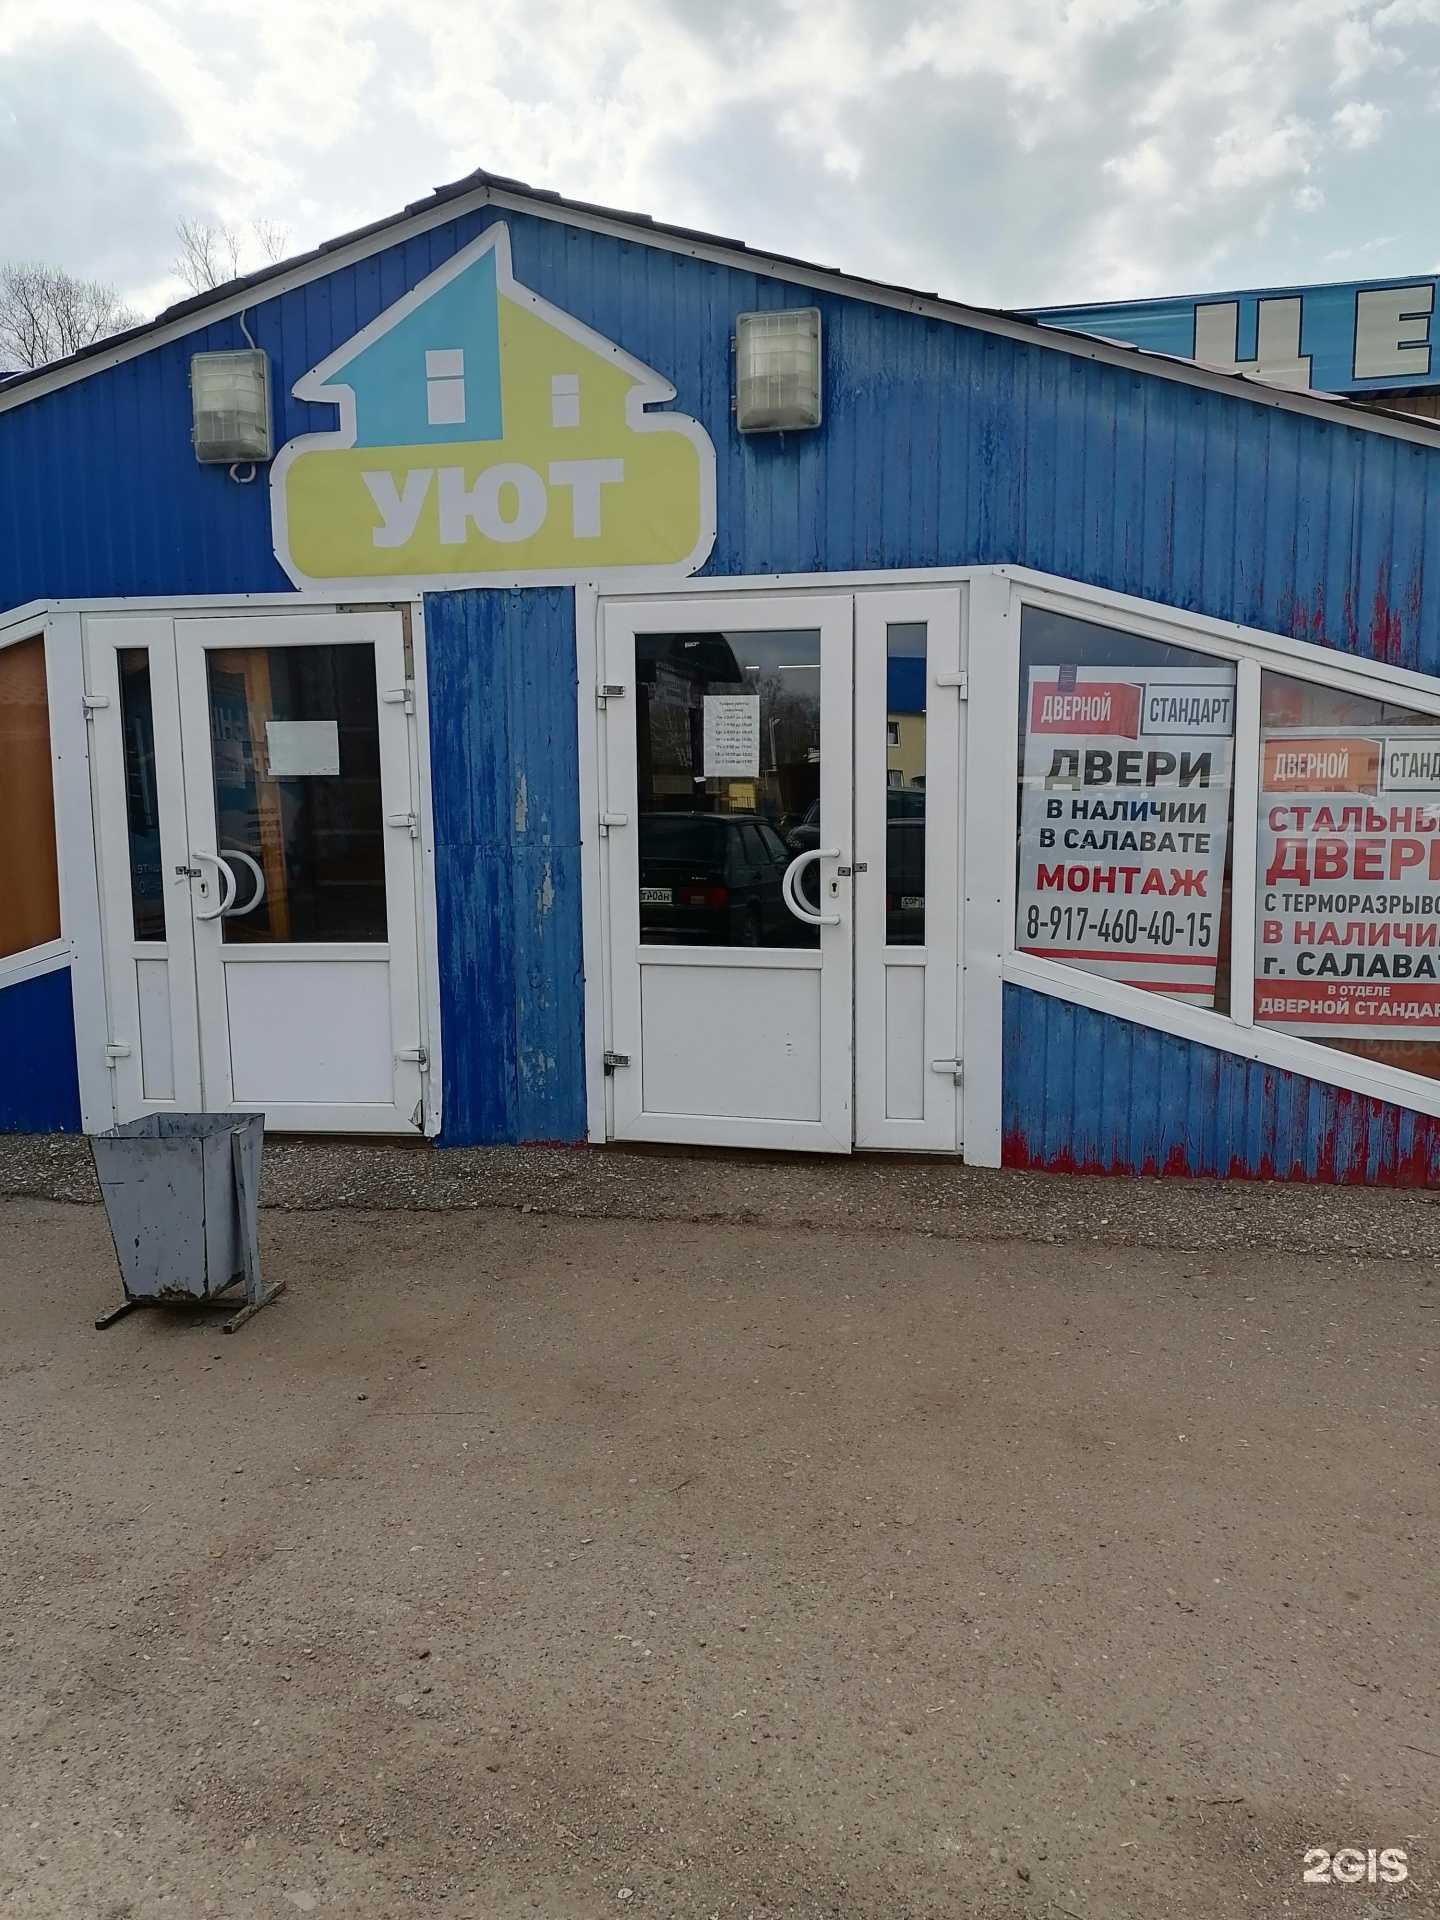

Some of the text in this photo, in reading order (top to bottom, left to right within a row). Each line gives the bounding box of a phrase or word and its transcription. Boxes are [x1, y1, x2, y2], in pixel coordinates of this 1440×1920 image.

[360, 457, 625, 548] УЮТ
[1041, 690, 1230, 726] ДВЕРНОЙ СТАНДАРТ
[1044, 749, 1212, 791] ДВЕРИ
[1273, 747, 1349, 781] ДВЕРНОЙ
[1047, 799, 1207, 824] В НАЛИЧИИ
[1040, 828, 1211, 853] В САЛАВАТЕ
[1036, 863, 1209, 897] МОНТАЖ
[1264, 892, 1277, 912] С
[1026, 904, 1212, 948] 8-917-460-40-15
[1263, 920, 1440, 948] В НАЛИЧИ
[1263, 951, 1440, 978] г. САЛАВА
[1339, 985, 1391, 997] ОТДЕЛЕ
[1258, 998, 1349, 1015] ДВЕРНОЙ
